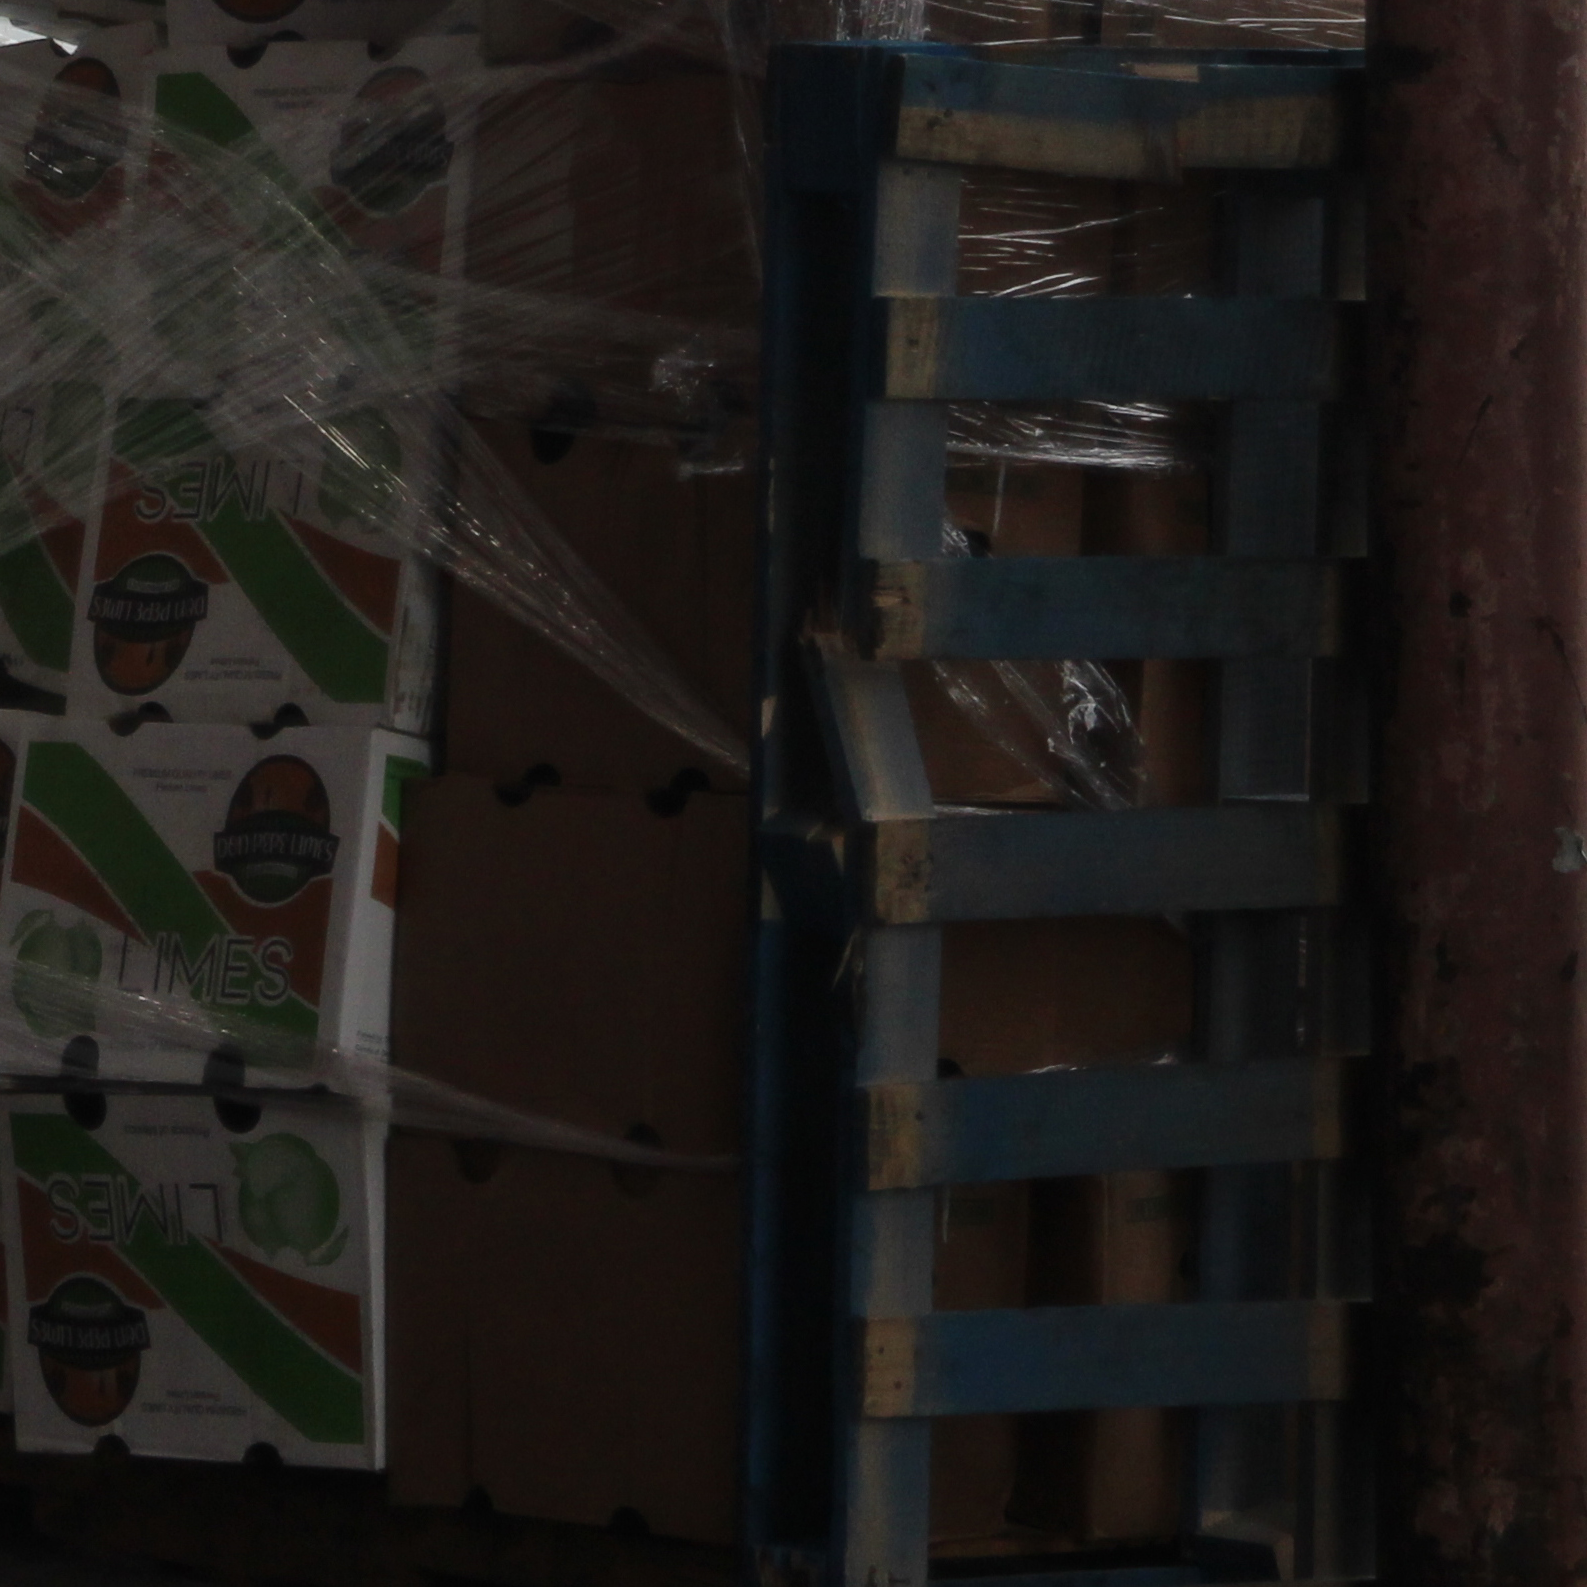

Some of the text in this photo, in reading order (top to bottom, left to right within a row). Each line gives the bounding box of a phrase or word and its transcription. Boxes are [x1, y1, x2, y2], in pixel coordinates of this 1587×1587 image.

[133, 456, 303, 522] LIMES
[117, 933, 295, 1007] LIMES
[46, 1172, 223, 1245] LIMES
